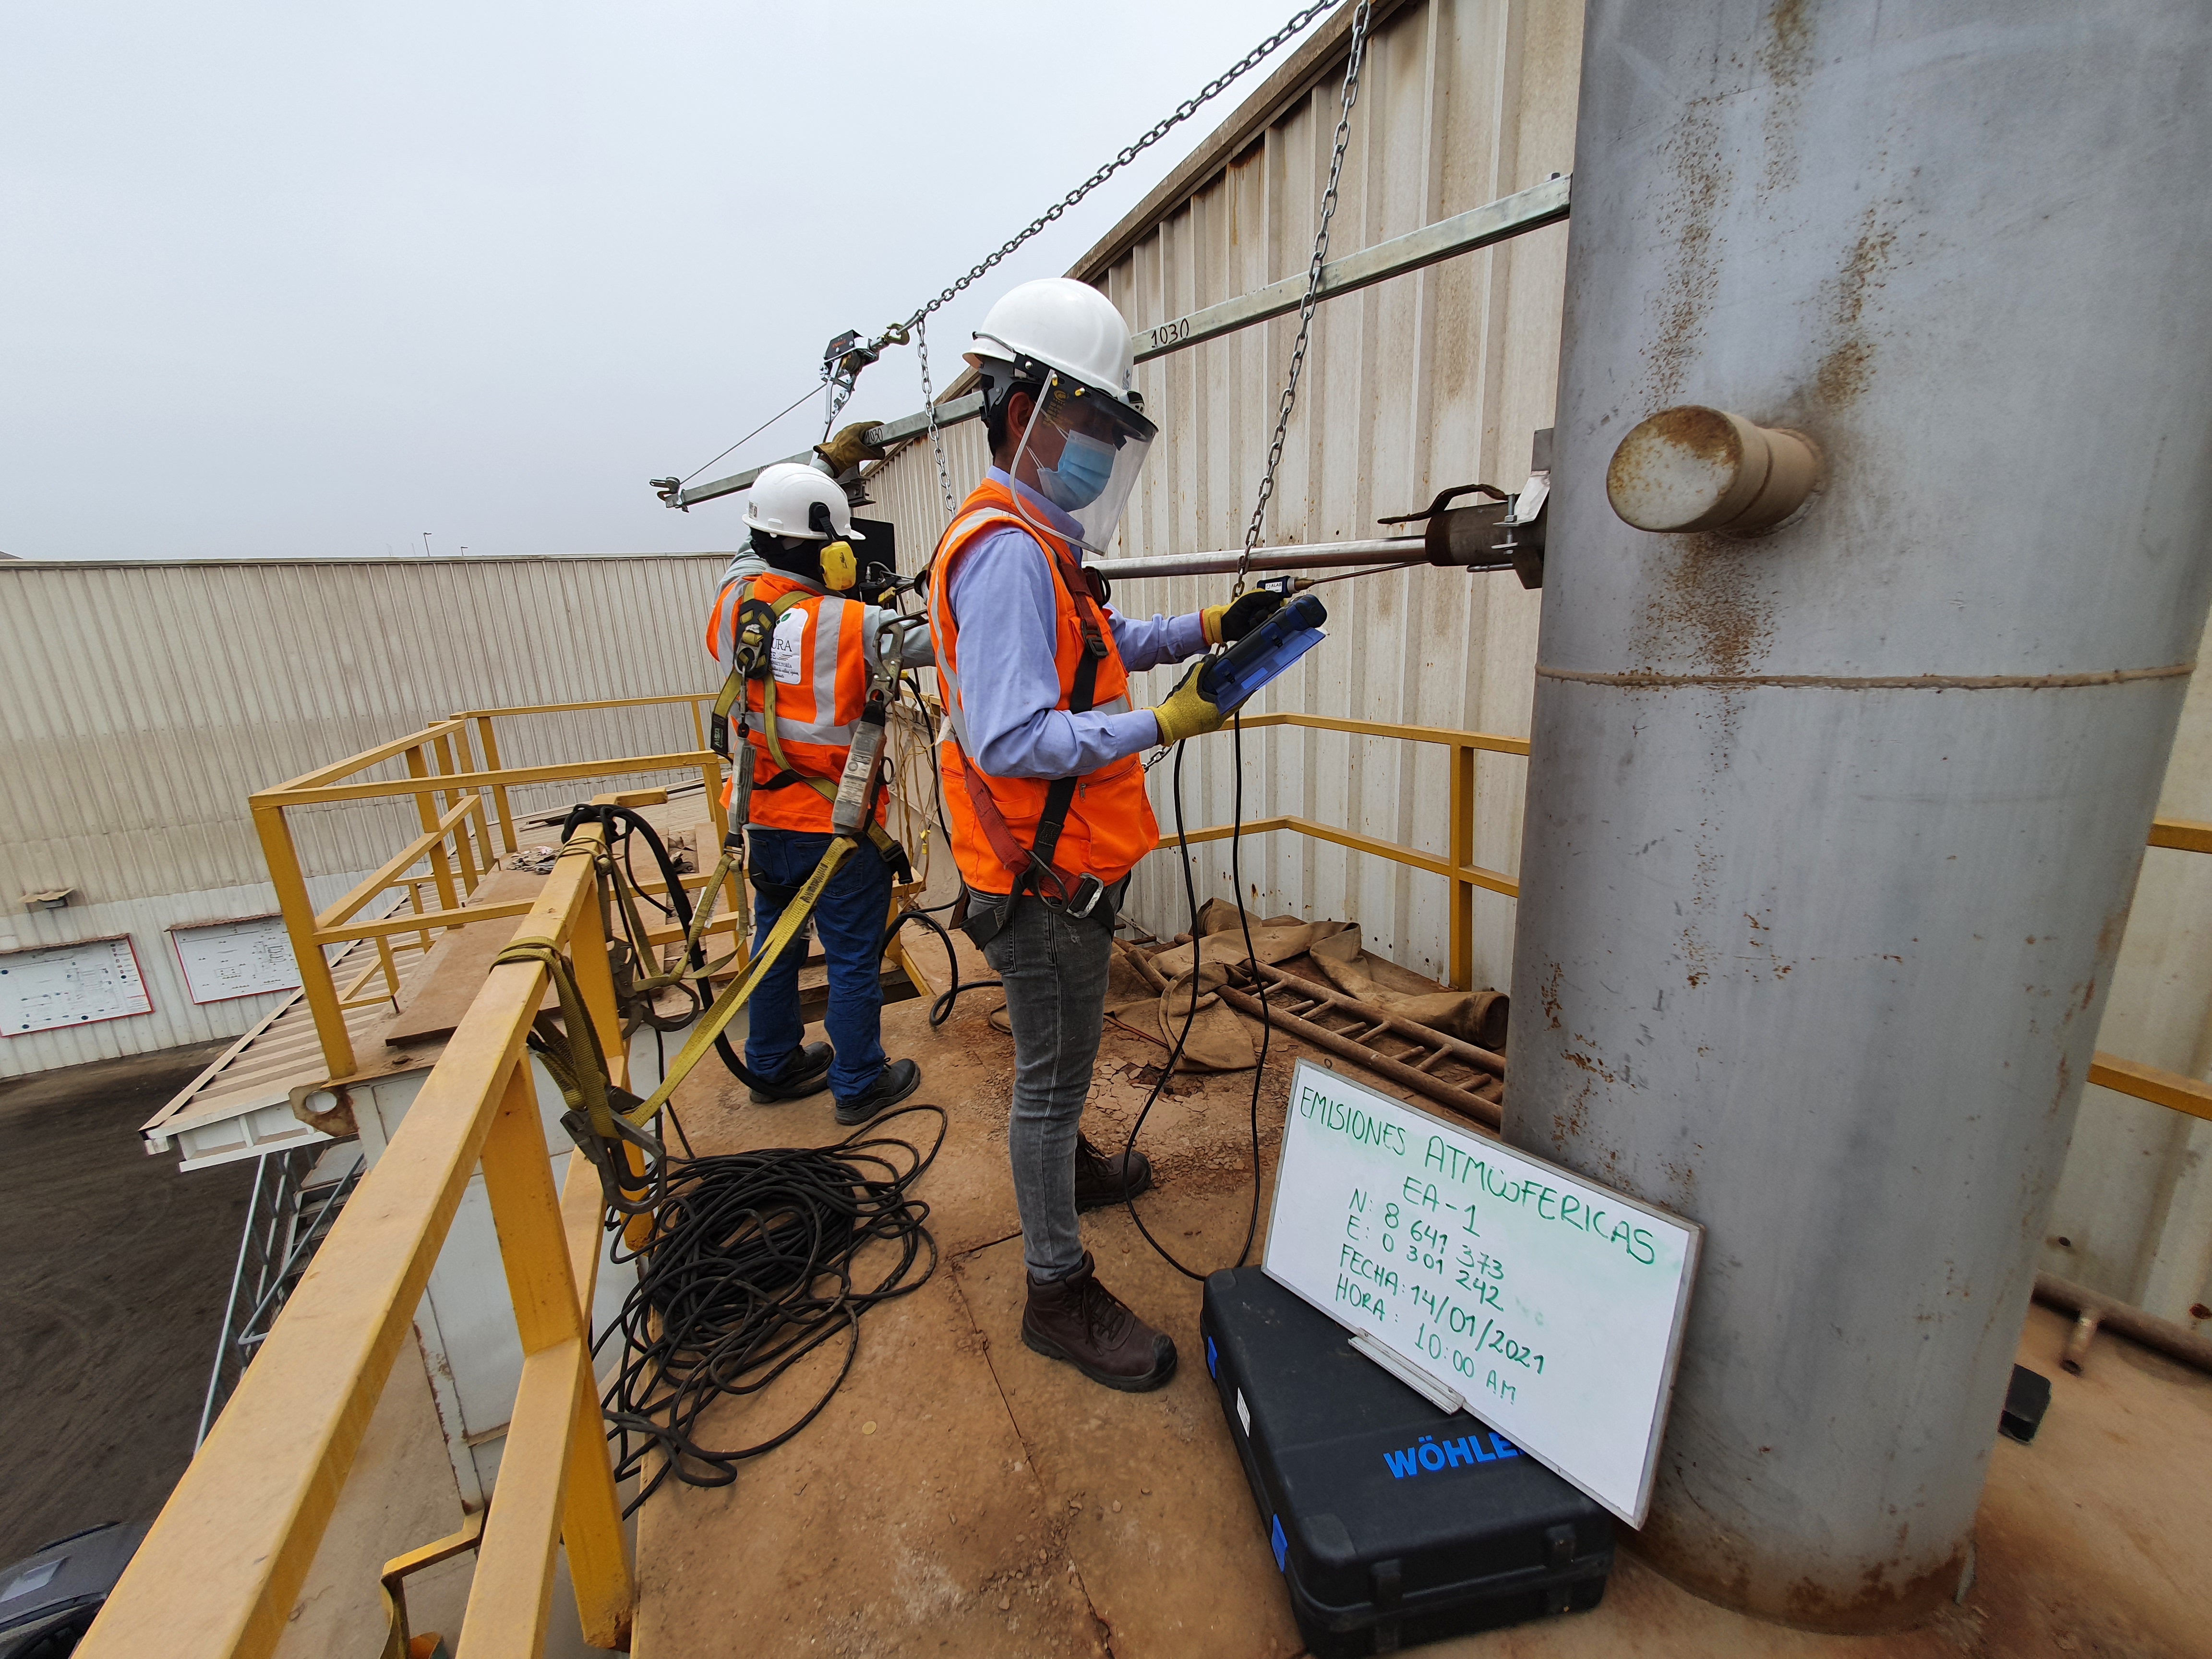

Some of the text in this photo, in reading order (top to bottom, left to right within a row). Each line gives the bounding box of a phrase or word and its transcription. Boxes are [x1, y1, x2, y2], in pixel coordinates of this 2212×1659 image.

[1151, 318, 1190, 348] 1030
[865, 428, 883, 445] 1030
[1300, 1086, 1406, 1156] EMISIONES
[1346, 1214, 1504, 1312] E: 0 301 242
[1348, 1188, 1504, 1280] N: 8 641 373
[1339, 1243, 1544, 1375] FECHA: 14/01/2021
[1414, 1322, 1475, 1378] 10:00
[1383, 1432, 1524, 1479] WÖHLE
